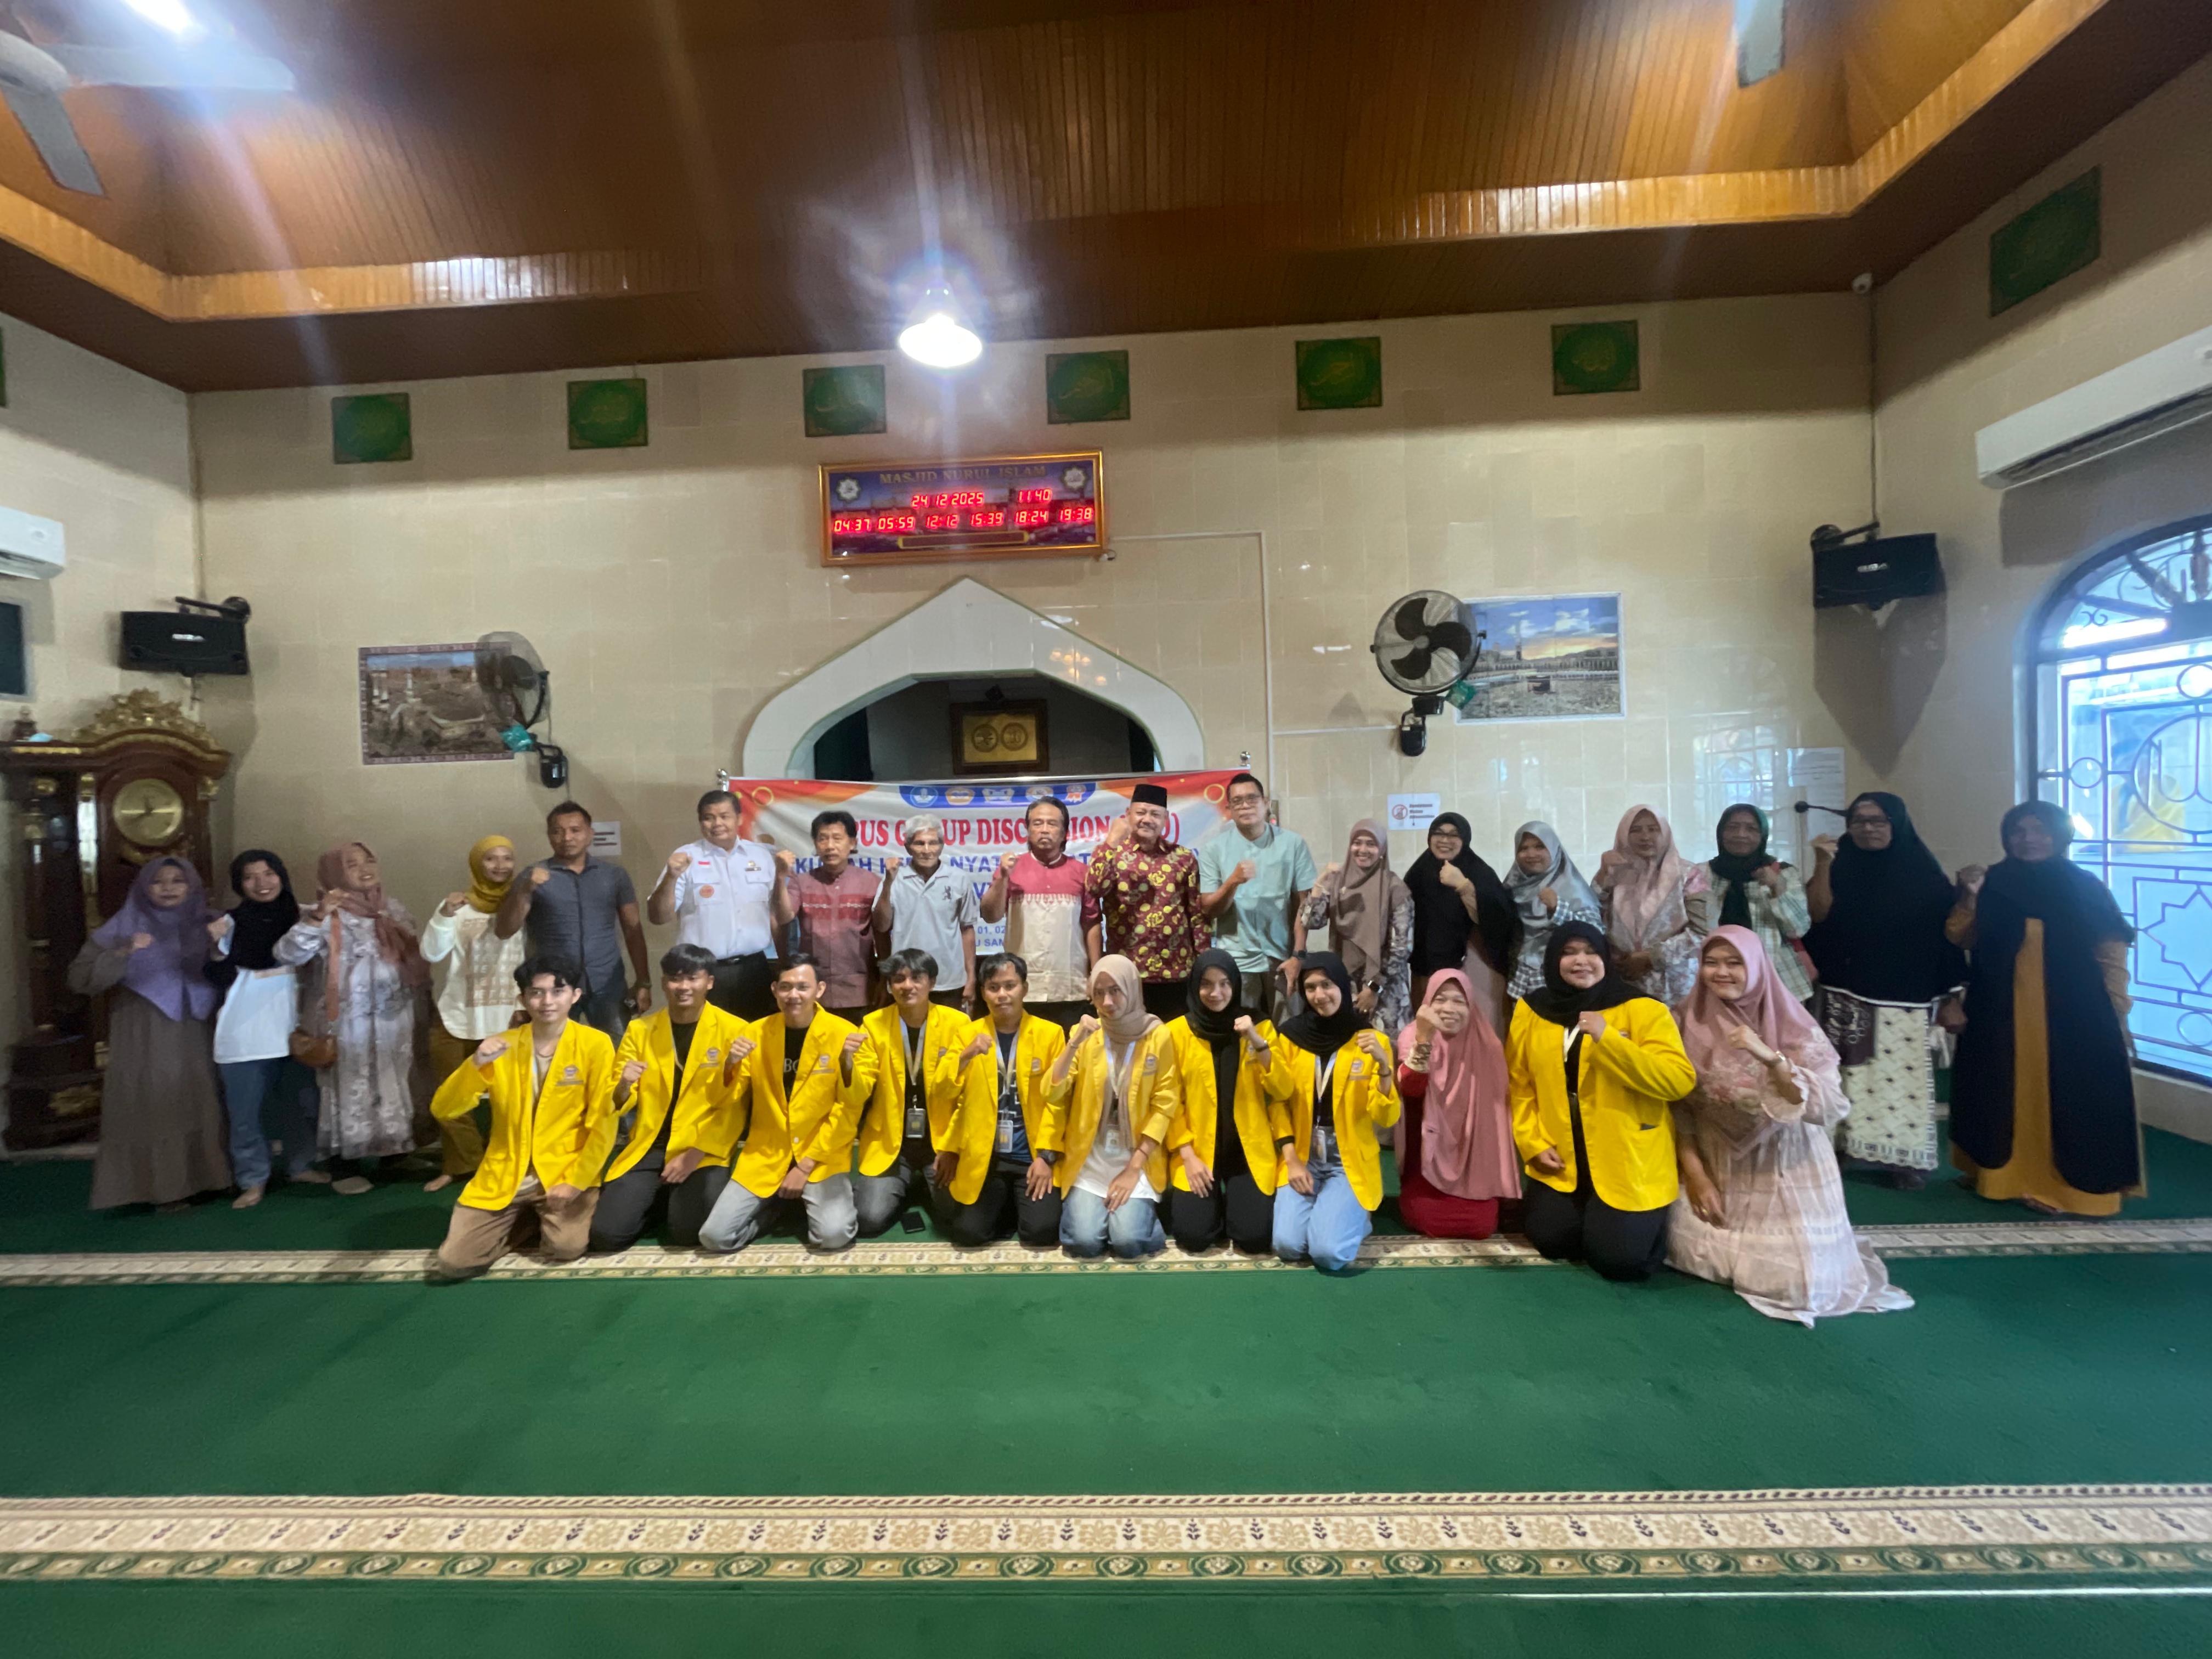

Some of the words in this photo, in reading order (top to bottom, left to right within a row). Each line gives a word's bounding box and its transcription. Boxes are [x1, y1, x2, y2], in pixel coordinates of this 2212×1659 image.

[879, 471, 937, 483] MASJID
[943, 469, 990, 481] NURUL
[998, 466, 1046, 478] ISLAM
[834, 518, 871, 532] 04:37
[878, 516, 915, 529] 05:59
[927, 514, 960, 527] 12:12
[970, 512, 1003, 525] 15:39
[1015, 510, 1048, 523] 18:24
[1060, 507, 1093, 521] 19:38
[895, 819, 970, 846] GUP
[976, 816, 1110, 845] DISCION
